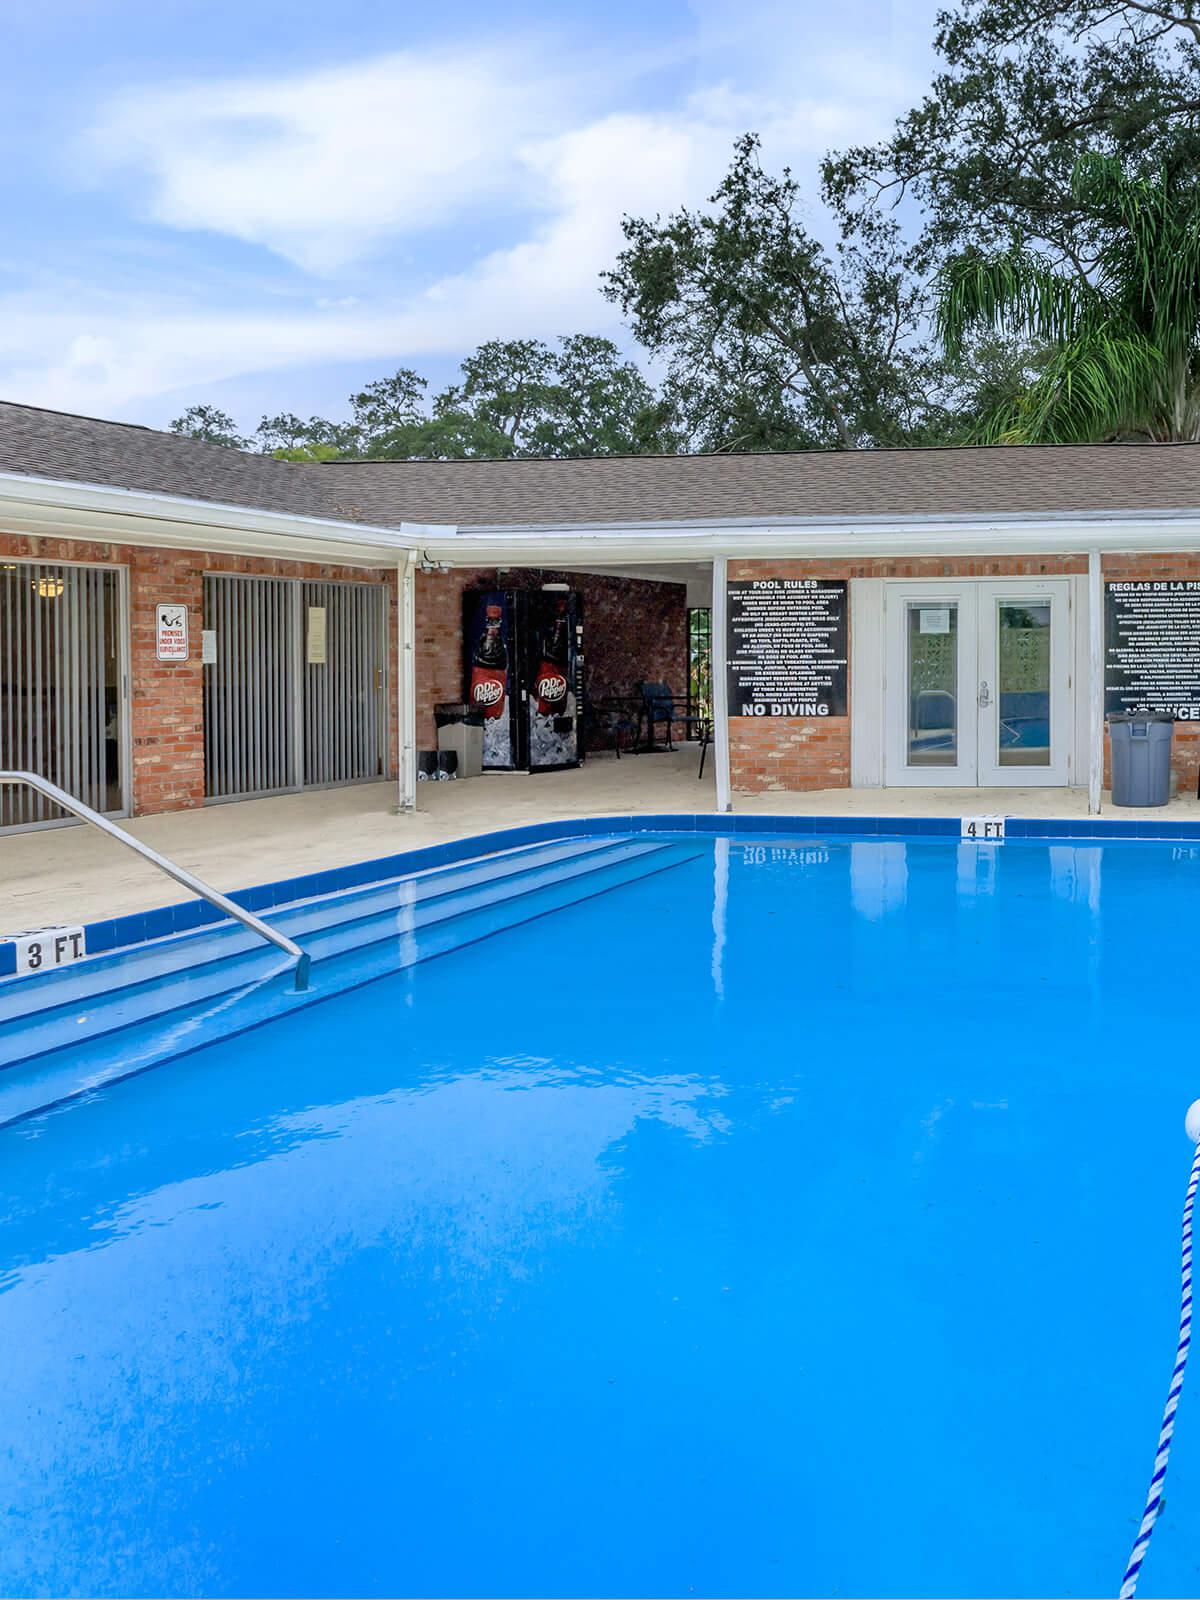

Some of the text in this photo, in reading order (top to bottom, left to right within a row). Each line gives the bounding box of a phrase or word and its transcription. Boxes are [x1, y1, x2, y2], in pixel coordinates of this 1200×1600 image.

[753, 580, 818, 589] POOL RULES
[1109, 582, 1151, 591] REGLAS
[1153, 582, 1168, 591] DE
[1170, 582, 1184, 591] LA
[484, 682, 496, 692] Dr
[550, 677, 561, 687] Dr
[475, 683, 500, 702] Pepper
[541, 678, 565, 698] Pepper
[742, 704, 829, 715] NO DIVING
[967, 822, 1002, 837] 4 FT.
[28, 932, 82, 968] 3 FT.
